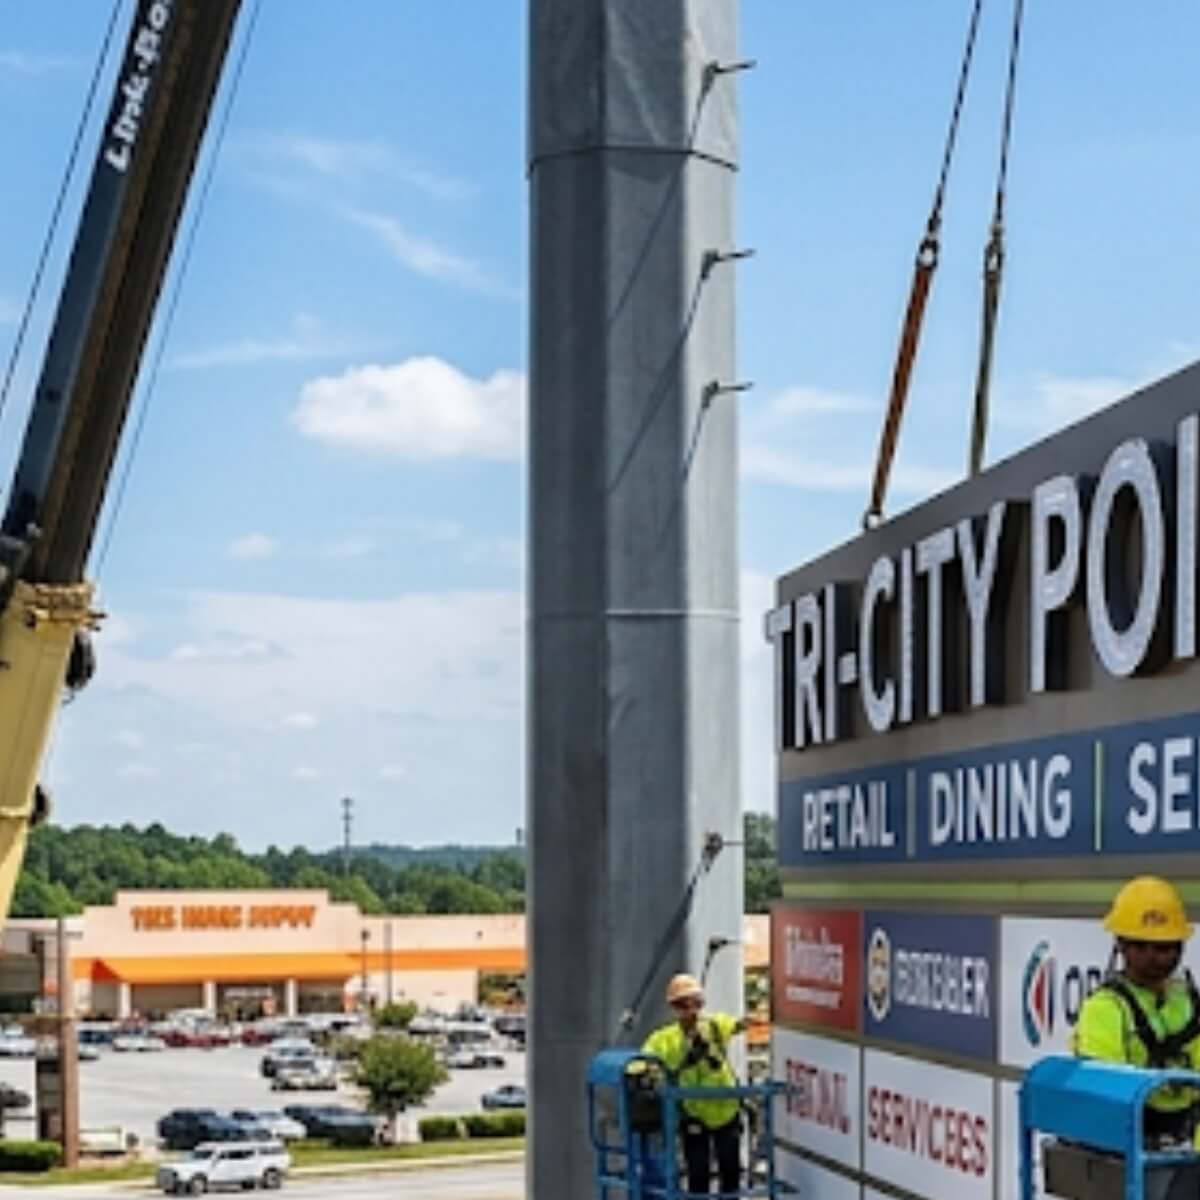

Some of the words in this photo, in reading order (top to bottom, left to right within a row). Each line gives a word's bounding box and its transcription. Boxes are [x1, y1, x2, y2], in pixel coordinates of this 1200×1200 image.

[766, 500, 1006, 748] TRI-CITY
[802, 782, 895, 851] RETAIL
[929, 754, 1072, 846] DINING
